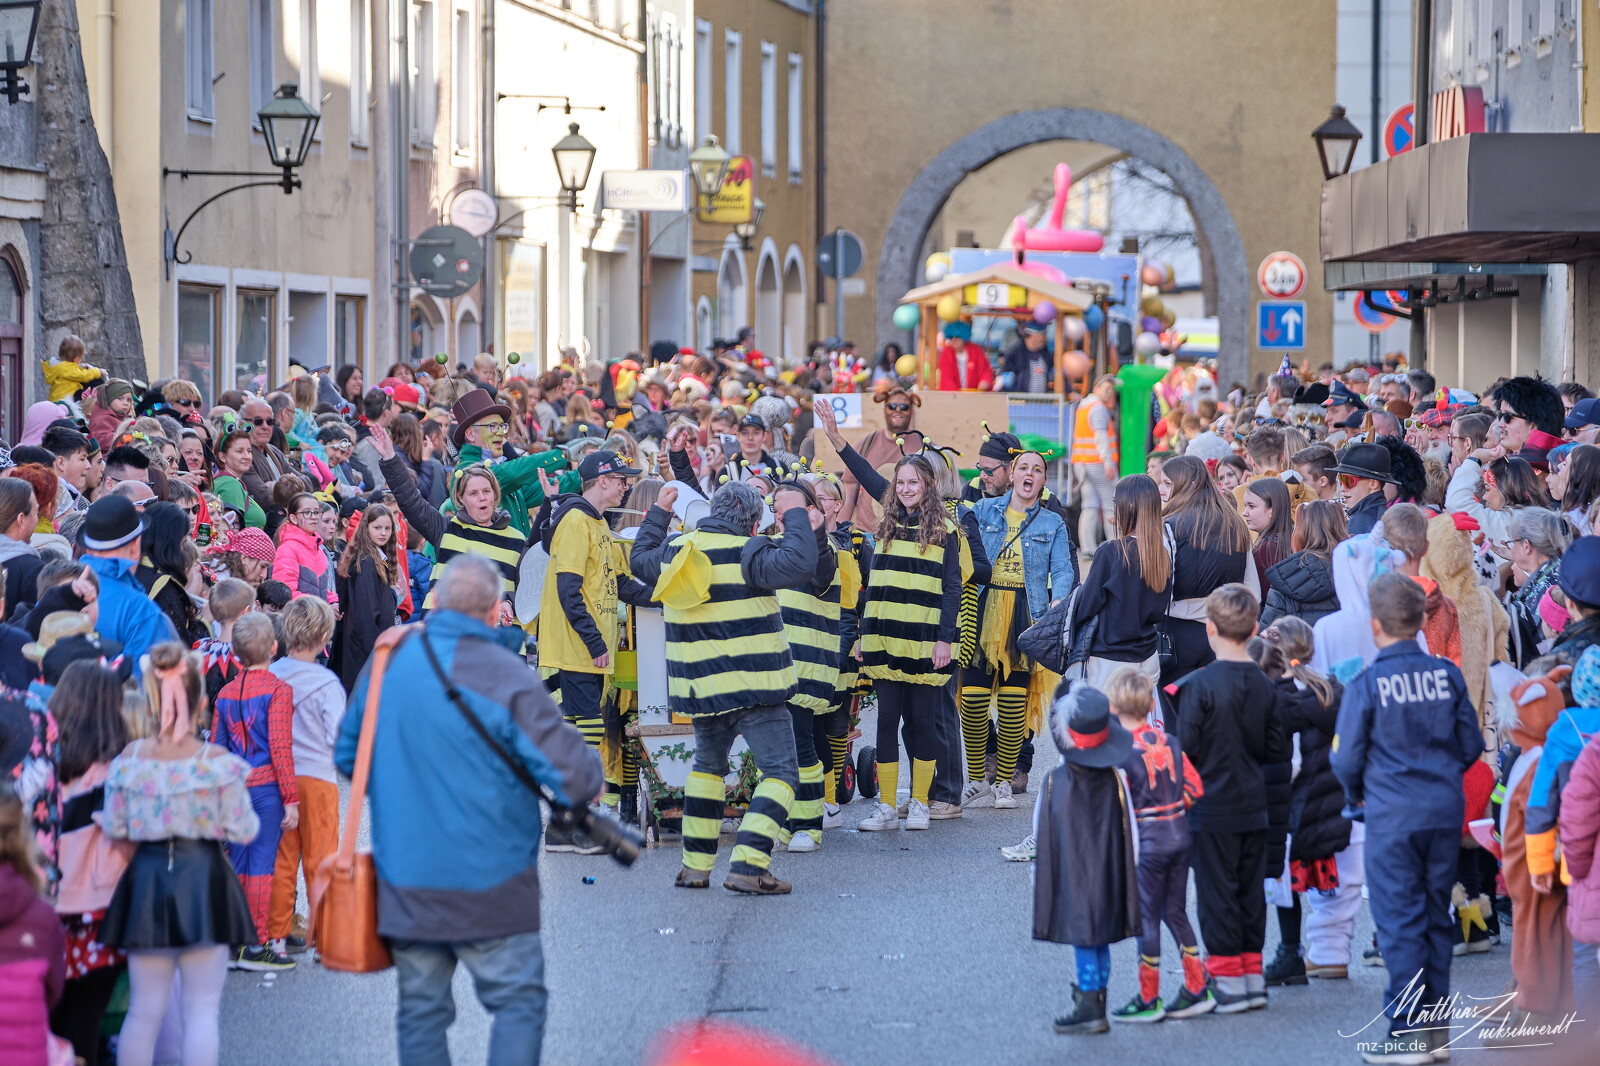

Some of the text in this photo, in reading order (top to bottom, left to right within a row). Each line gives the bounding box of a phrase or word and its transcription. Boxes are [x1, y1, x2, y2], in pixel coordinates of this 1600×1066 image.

[986, 285, 998, 303] 9
[832, 396, 848, 425] 8
[1376, 668, 1451, 707] POLICE
